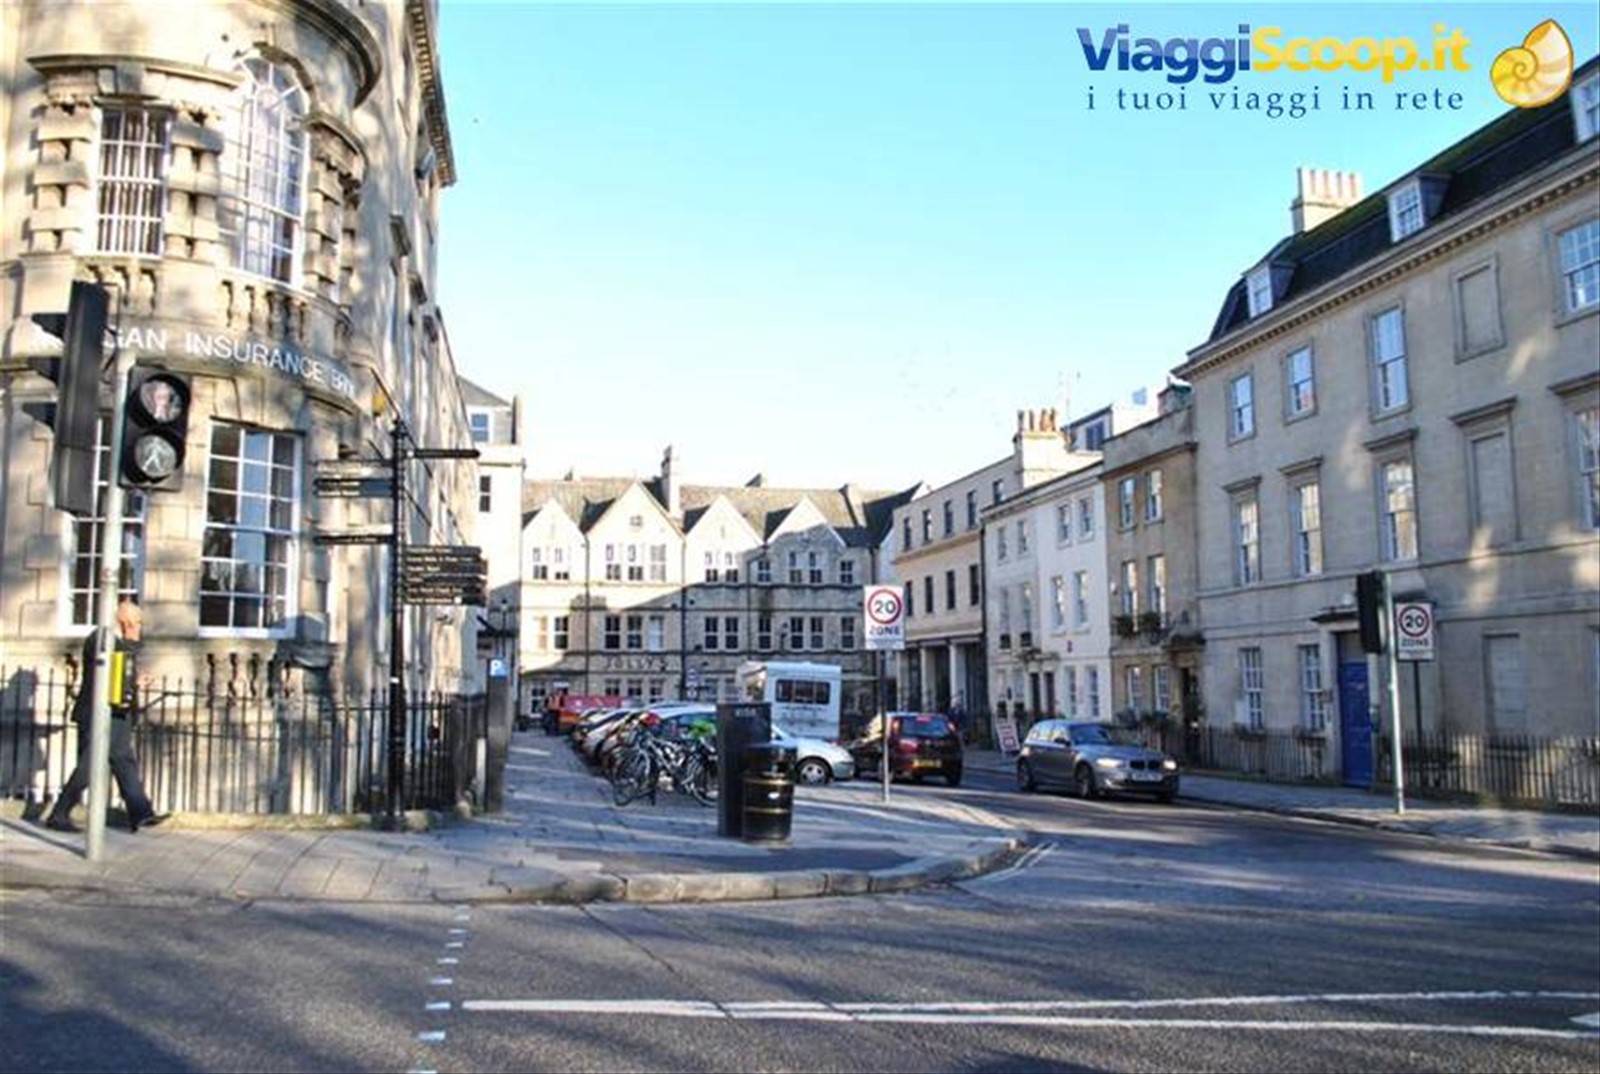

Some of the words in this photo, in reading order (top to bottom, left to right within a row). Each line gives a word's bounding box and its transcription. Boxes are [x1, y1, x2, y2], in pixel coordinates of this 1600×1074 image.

[185, 332, 325, 384] INSURANCE
[874, 600, 896, 614] 20
[1404, 614, 1425, 628] 20
[868, 624, 900, 636] ZONE
